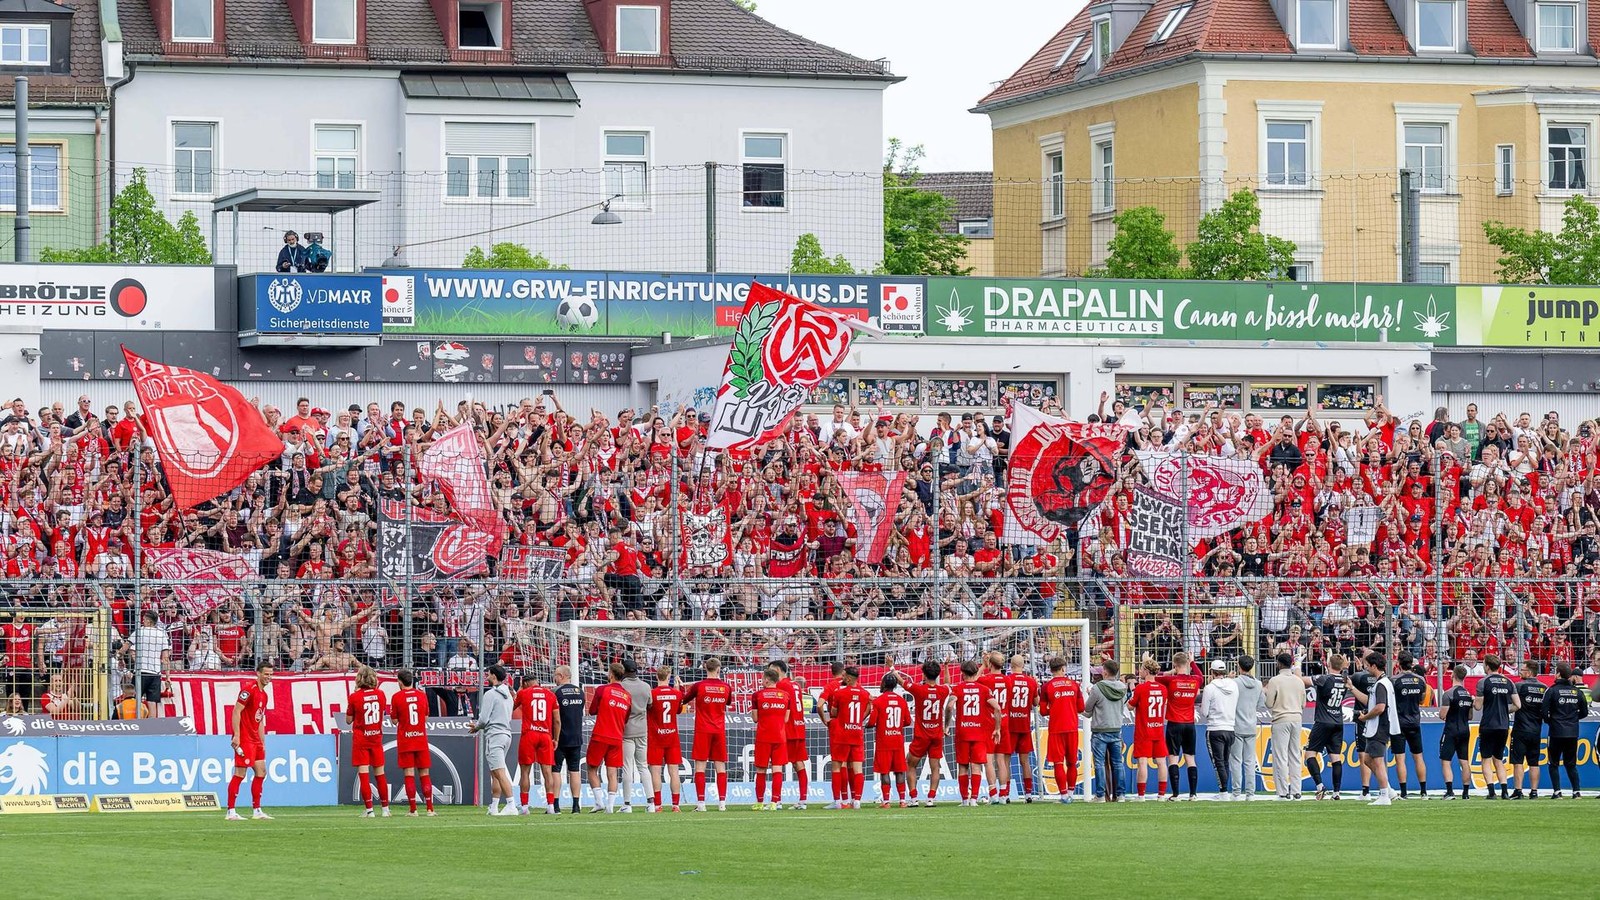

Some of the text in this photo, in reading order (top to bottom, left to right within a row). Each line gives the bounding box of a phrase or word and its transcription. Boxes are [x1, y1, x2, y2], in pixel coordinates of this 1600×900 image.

[0, 282, 106, 300] BRÖTJE
[984, 286, 1164, 318] DRAPALIN
[0, 305, 106, 316] HEIZUNG
[914, 286, 922, 320] wohnen
[1174, 293, 1404, 332] Cann a bissl mehr!
[270, 317, 370, 329] Sicherheitsdienste
[883, 312, 915, 321] schöner
[990, 320, 1158, 333] PHARMACEUTICALS
[1526, 331, 1600, 342] FITN
[963, 694, 980, 716] 23
[1011, 686, 1029, 708] 33
[1148, 696, 1163, 718] 27
[1327, 687, 1345, 708] 35
[363, 701, 381, 725] 28
[408, 703, 419, 726] 6
[531, 699, 547, 722] 19
[662, 701, 672, 724] 2
[848, 701, 861, 724] 11
[886, 706, 901, 728] 30
[923, 699, 940, 721] 24
[31, 718, 55, 730] die
[63, 750, 332, 790] die Bayerche
[731, 785, 752, 797] die
